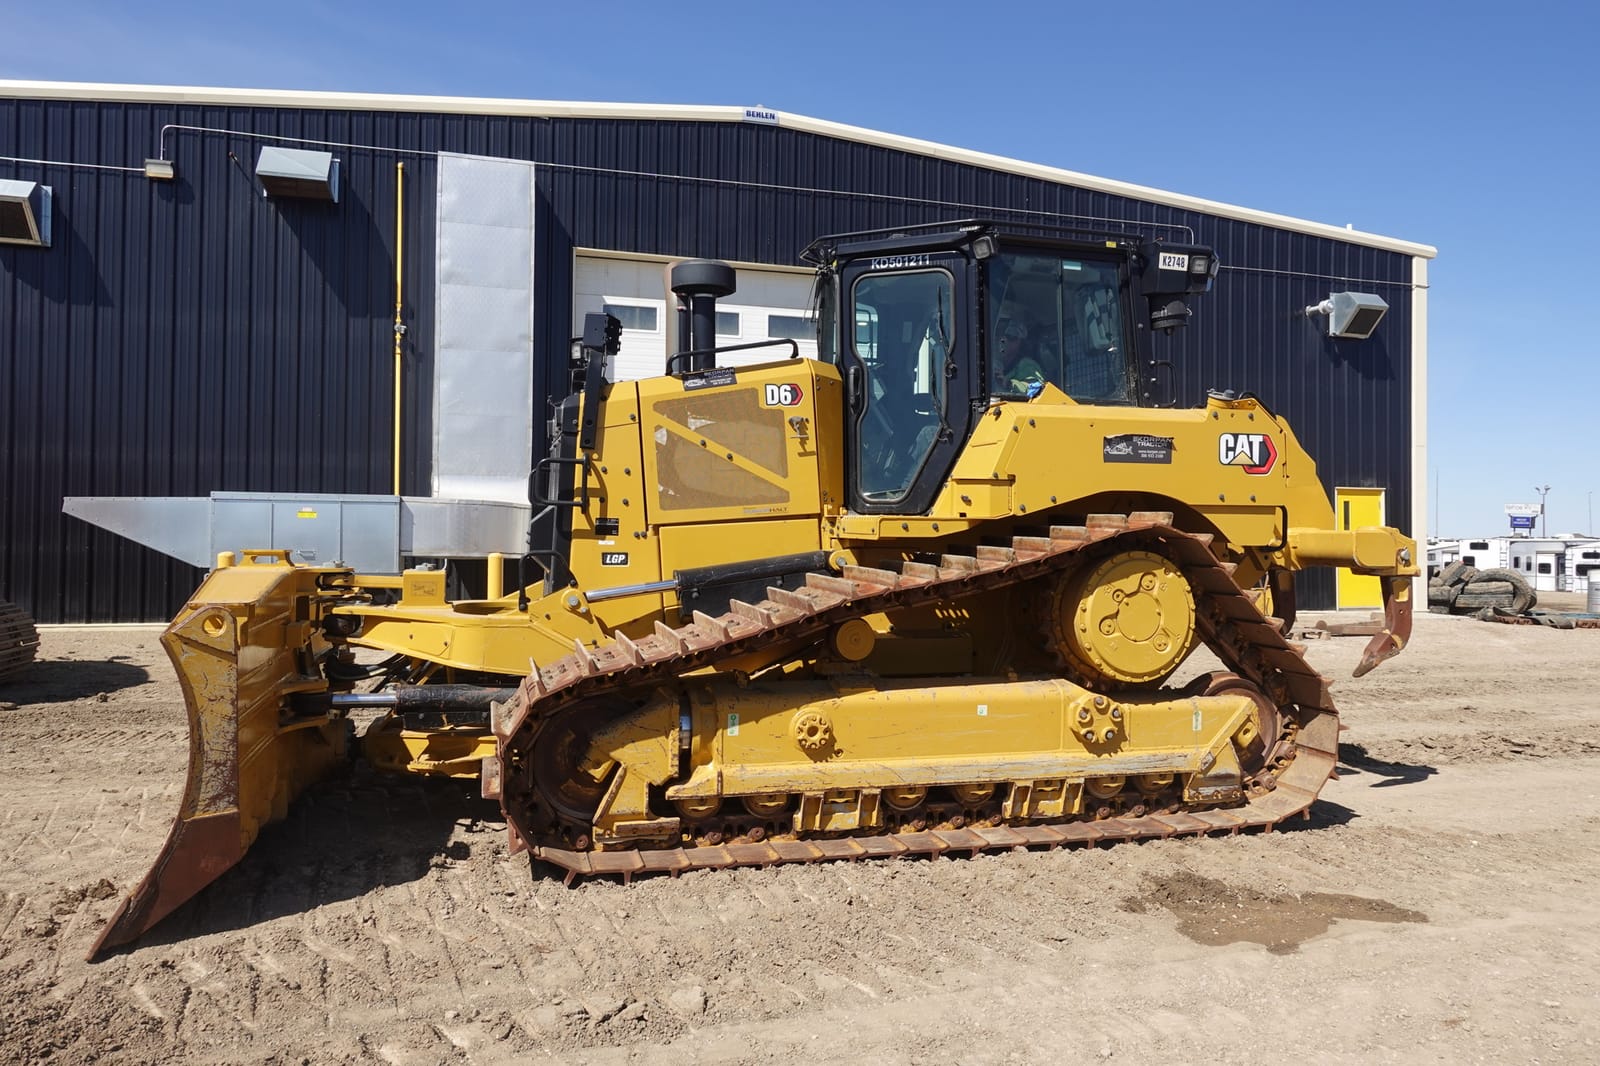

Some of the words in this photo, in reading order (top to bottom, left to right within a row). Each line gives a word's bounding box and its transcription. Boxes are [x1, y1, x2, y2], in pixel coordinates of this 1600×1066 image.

[746, 110, 775, 119] BEHLEN
[871, 254, 929, 269] KD501211
[1162, 255, 1185, 268] K2748
[765, 384, 792, 405] D6
[1220, 433, 1264, 465] CAT
[605, 554, 626, 564] LGP
